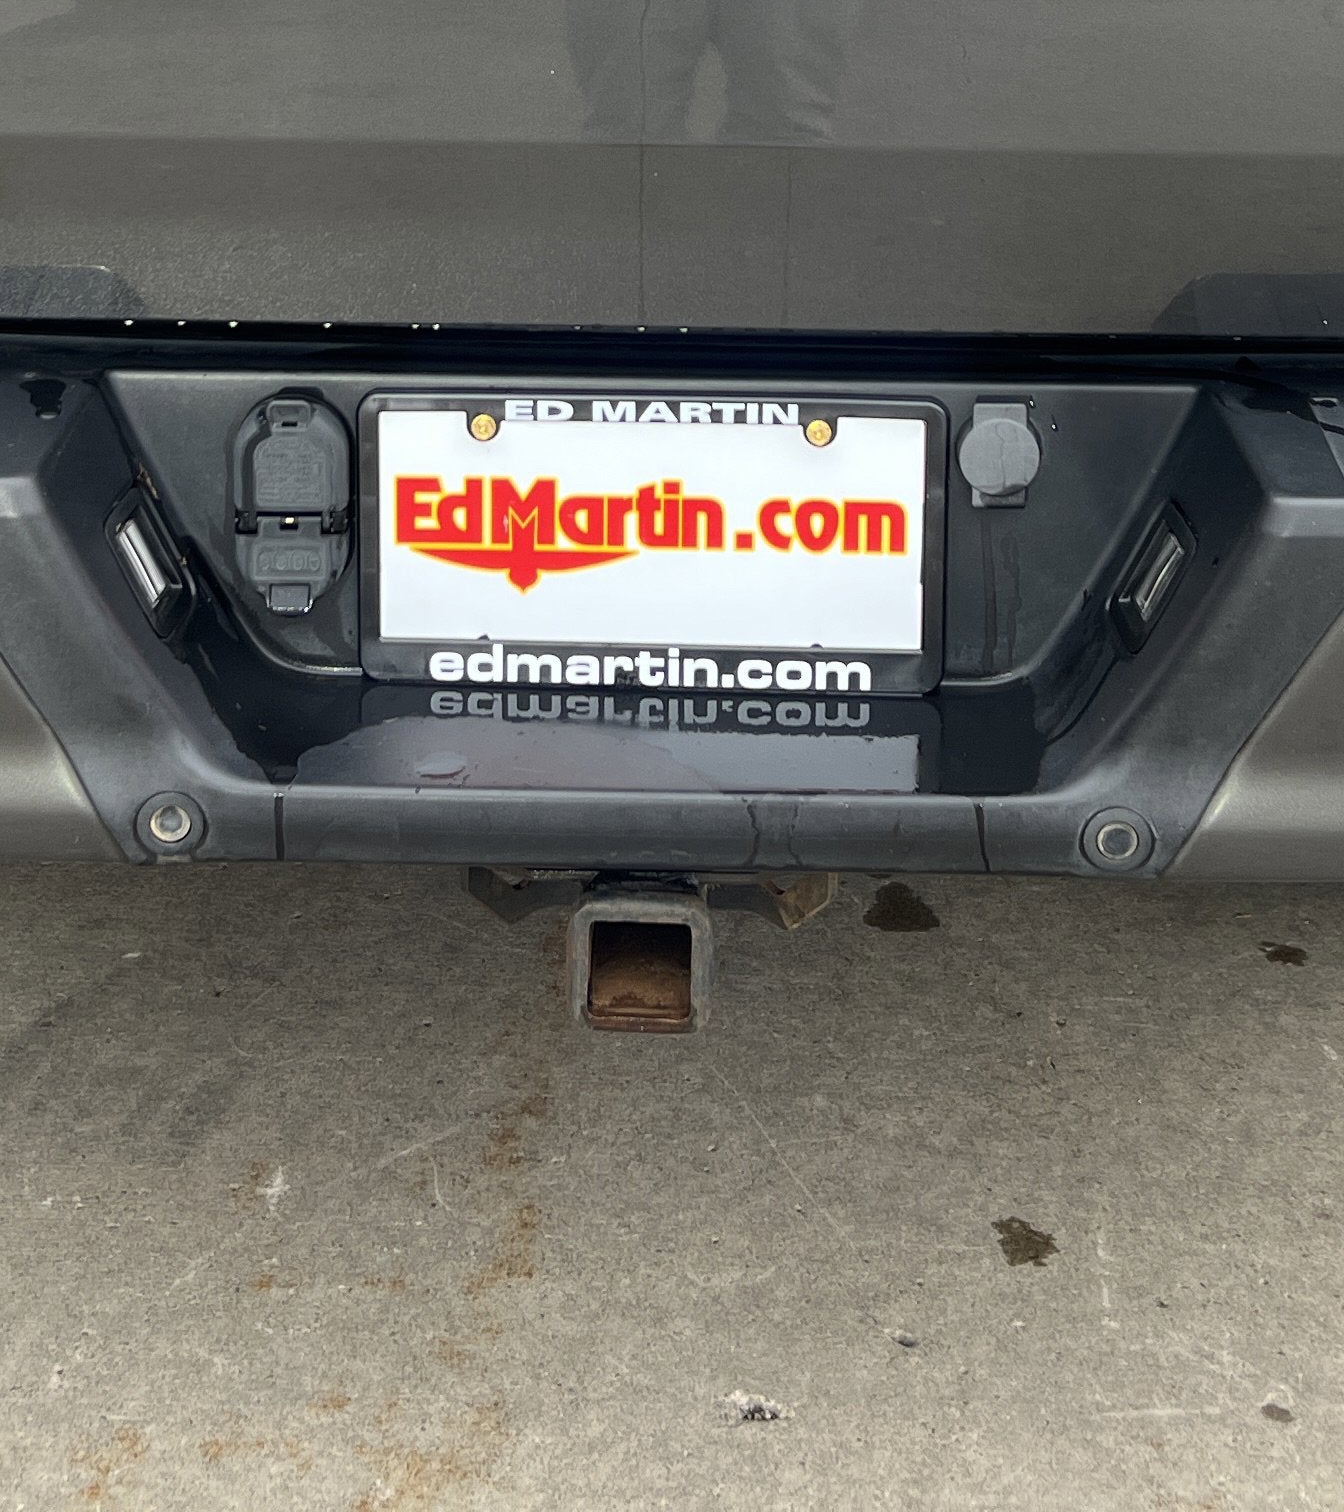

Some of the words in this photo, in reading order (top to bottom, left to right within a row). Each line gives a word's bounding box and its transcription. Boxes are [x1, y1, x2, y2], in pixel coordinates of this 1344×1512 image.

[505, 399, 574, 423] ED
[592, 400, 800, 426] MARTIN
[429, 643, 872, 691] edmartin.com
